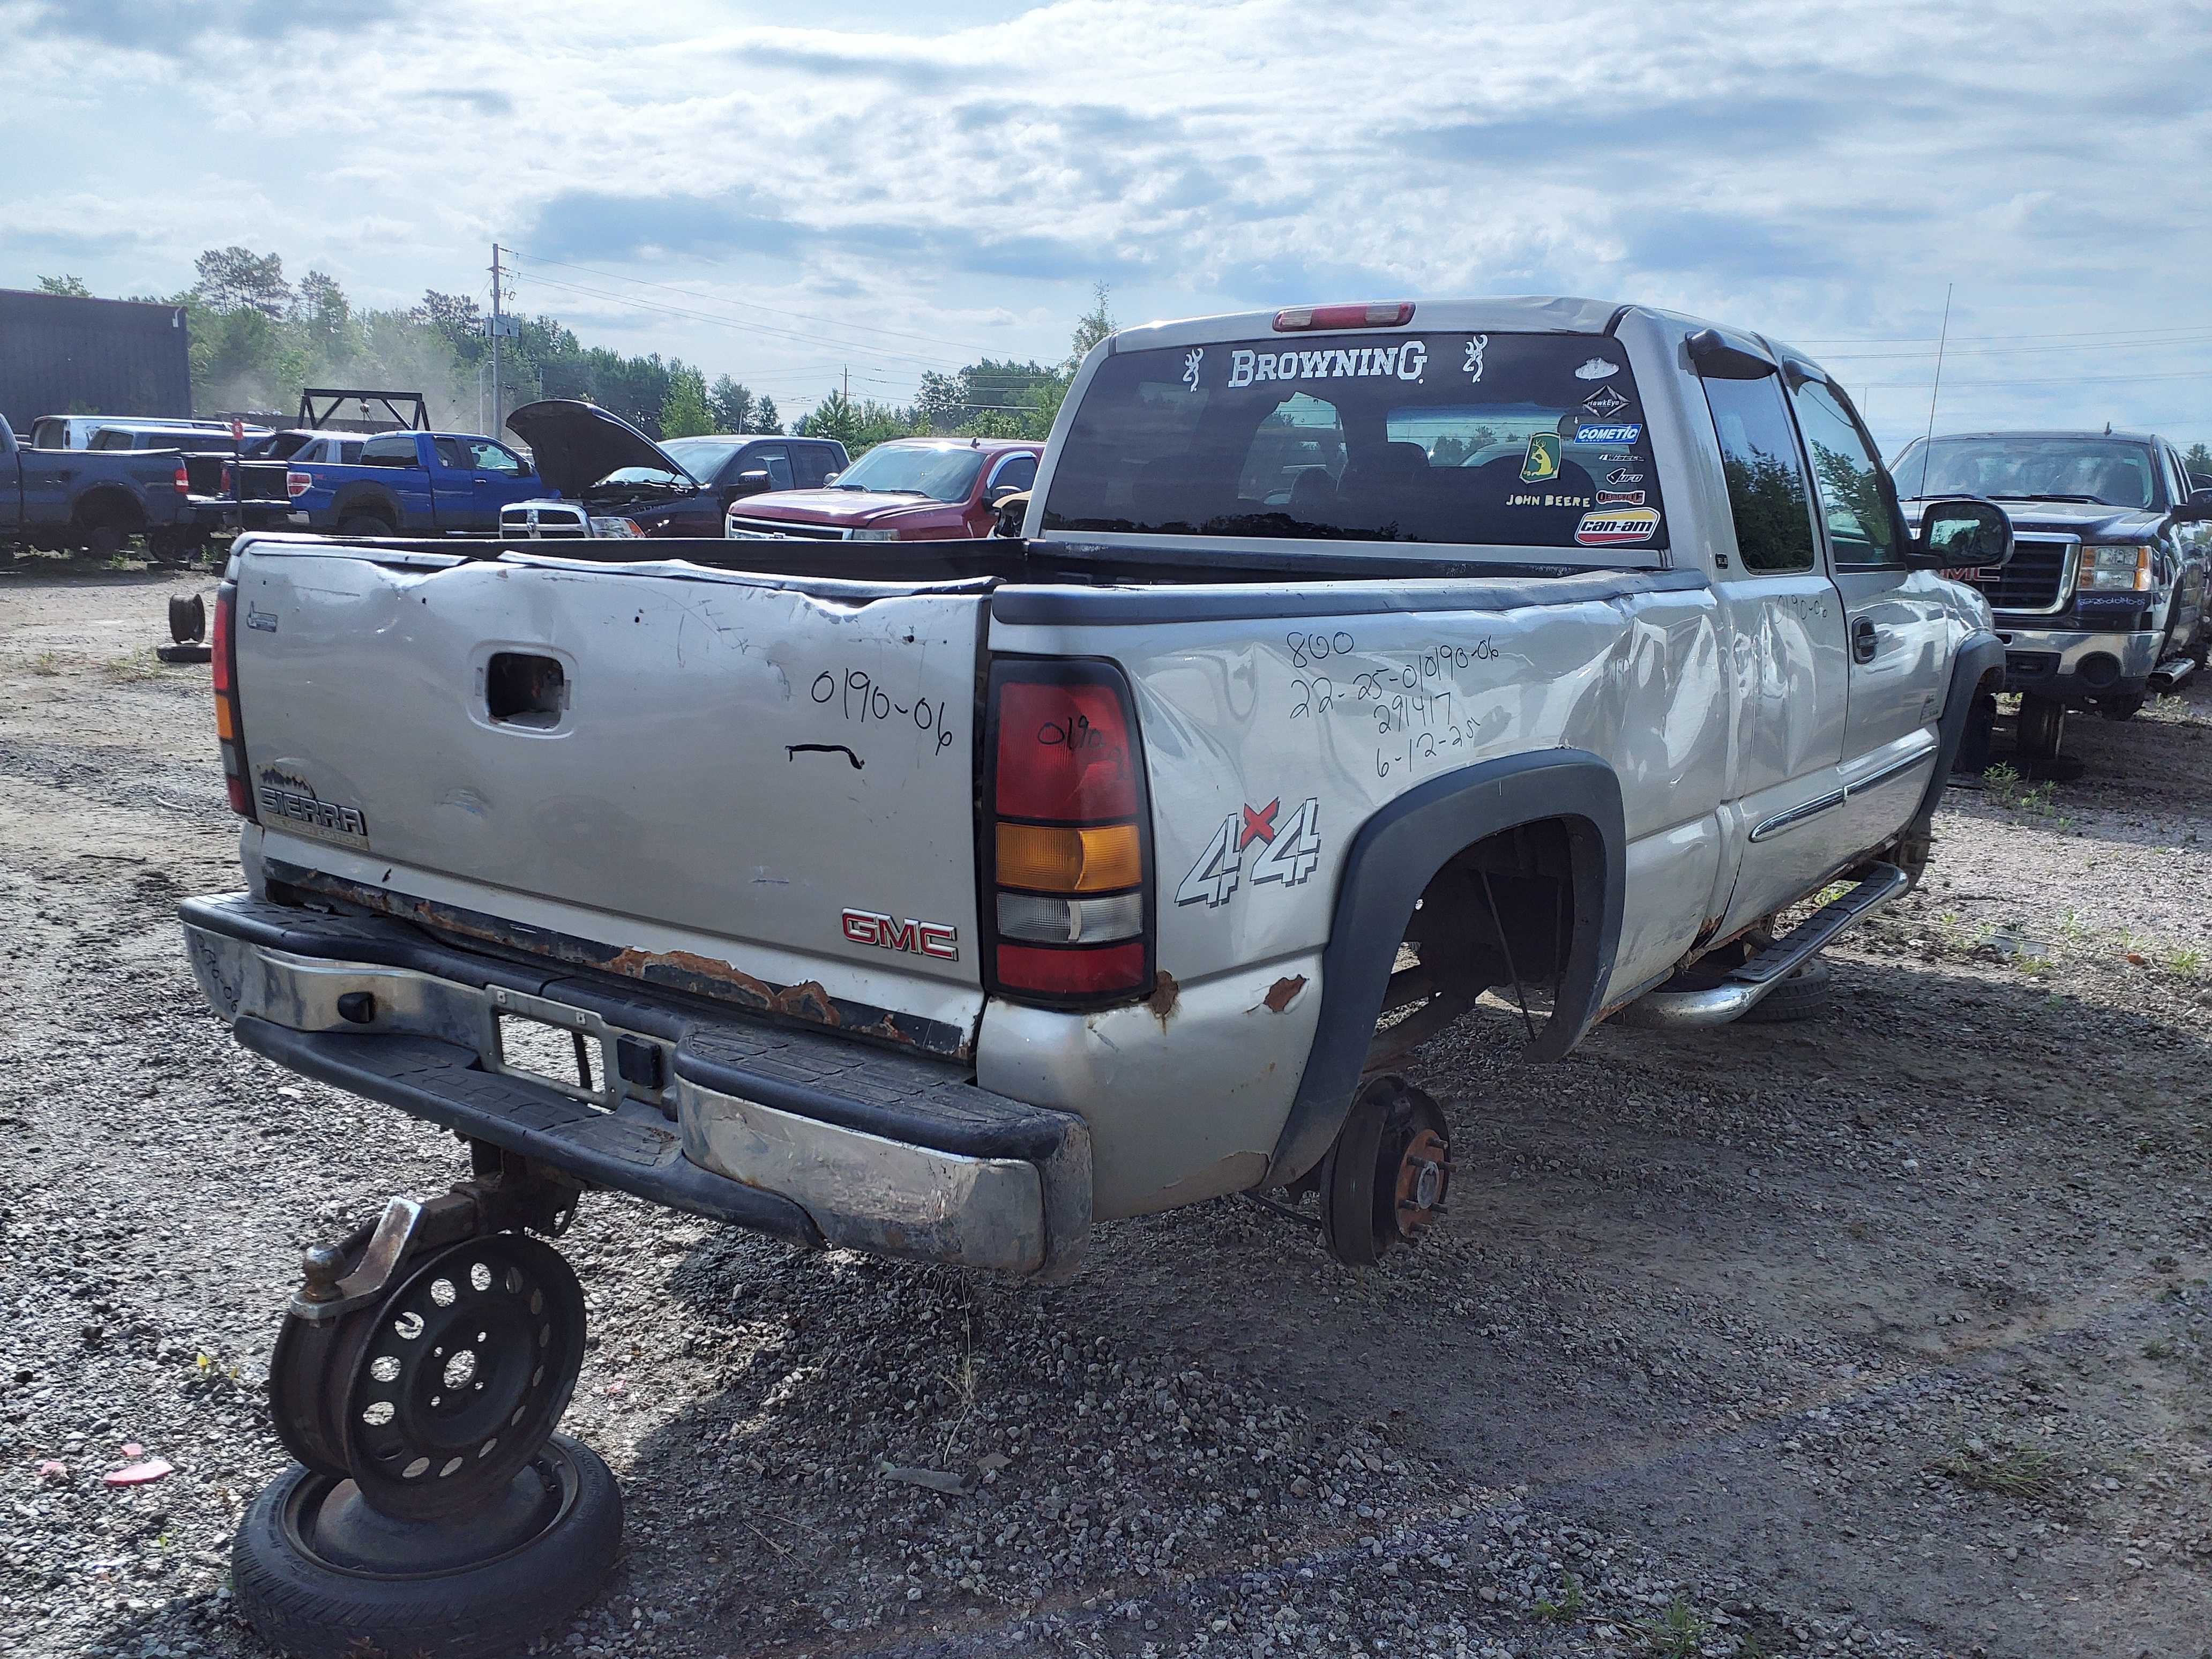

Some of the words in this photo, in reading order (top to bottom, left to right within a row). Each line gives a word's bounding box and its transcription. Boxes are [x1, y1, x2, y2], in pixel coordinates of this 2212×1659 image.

[1578, 428, 1638, 439] COMETIC
[1506, 494, 1540, 506] JOHN
[1544, 495, 1590, 507] BEERE
[1581, 520, 1654, 532] can-am
[1940, 564, 2001, 582] MC
[1287, 631, 1354, 668] 800
[811, 667, 953, 756] 0190-06
[1373, 691, 1451, 734] 291417
[1376, 716, 1481, 778] 6-12-25
[260, 786, 369, 836] SIERRA
[842, 907, 959, 962] GMC
